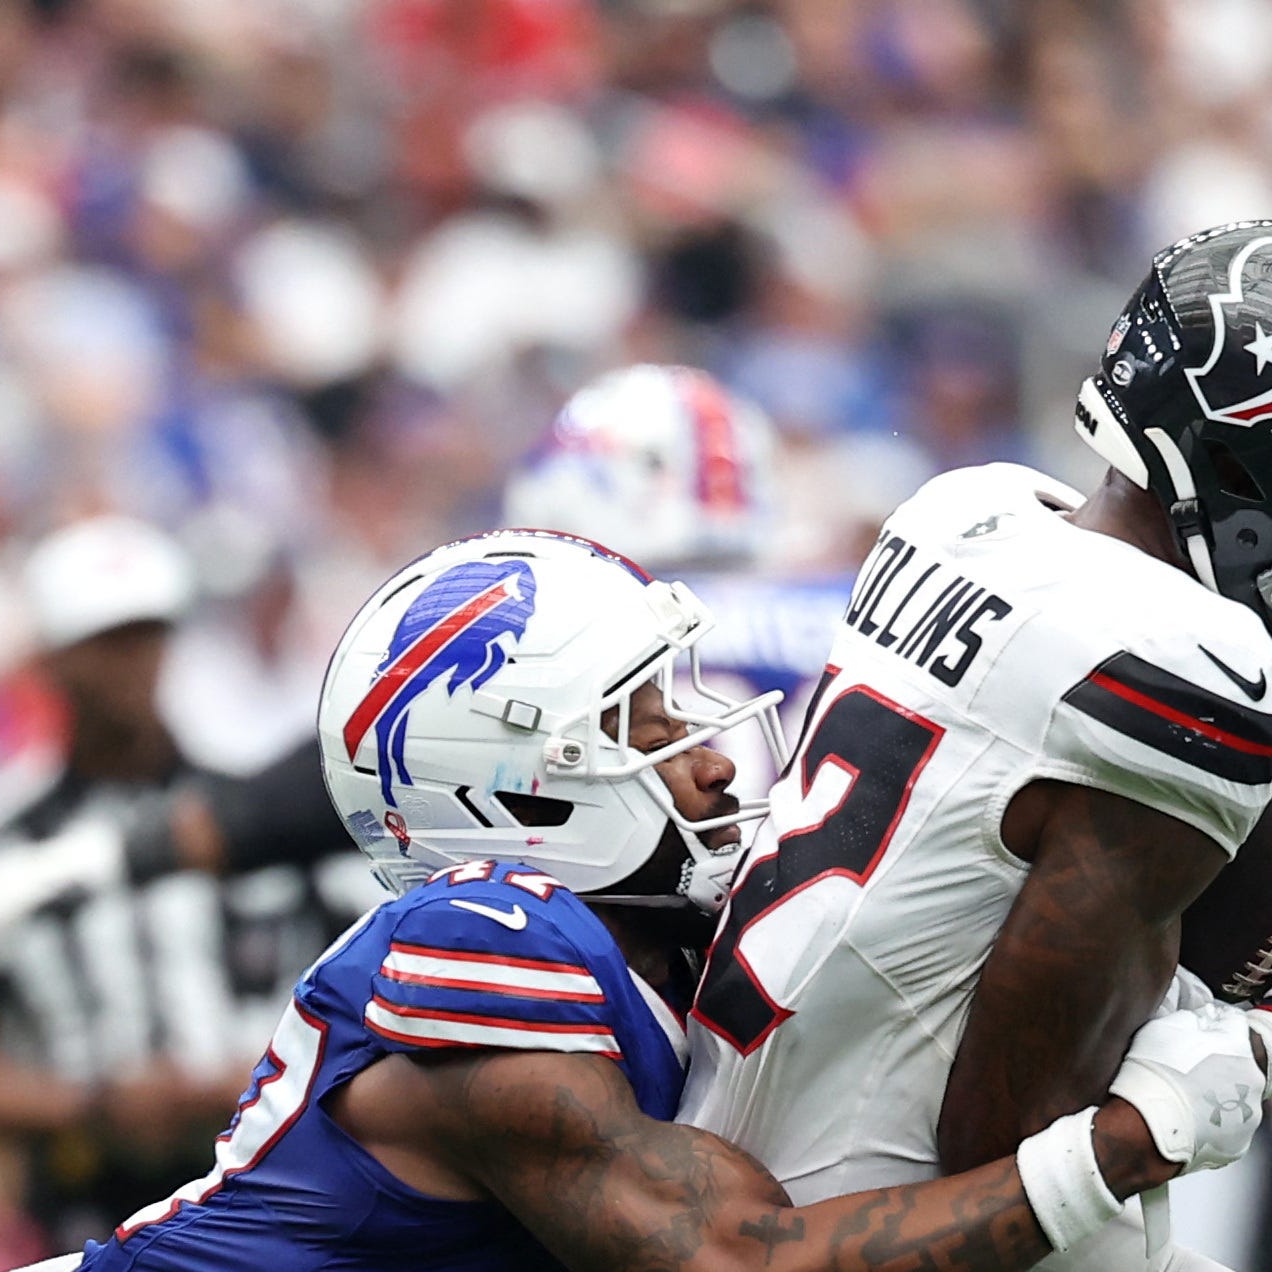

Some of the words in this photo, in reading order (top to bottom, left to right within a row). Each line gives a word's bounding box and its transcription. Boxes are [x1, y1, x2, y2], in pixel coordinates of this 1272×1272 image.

[841, 529, 1013, 688] OLLINS
[425, 859, 570, 903] 47
[690, 663, 947, 1058] 2
